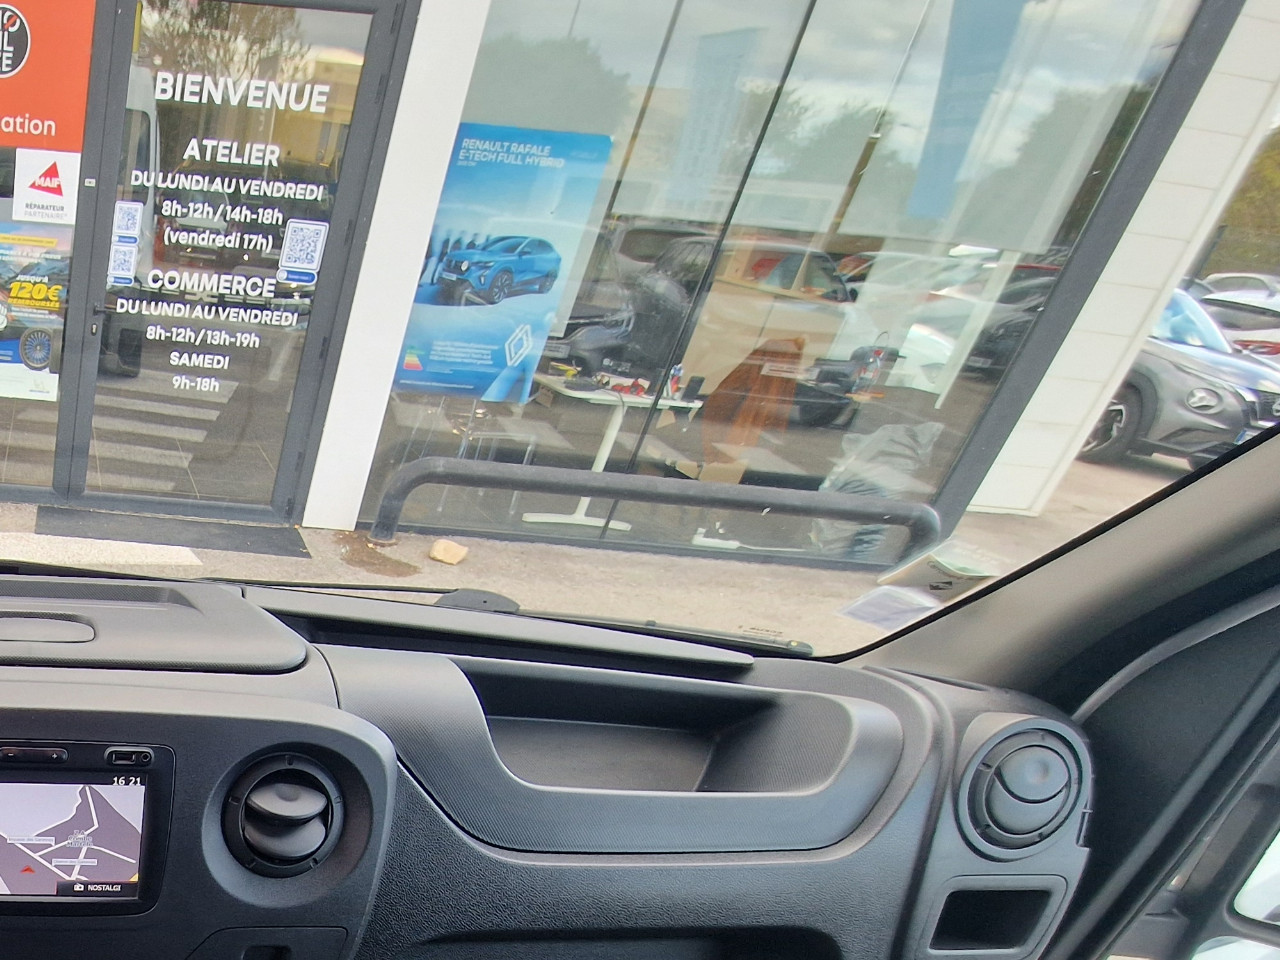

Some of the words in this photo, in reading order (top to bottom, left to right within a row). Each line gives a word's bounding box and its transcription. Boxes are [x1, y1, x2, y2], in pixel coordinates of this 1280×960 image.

[154, 71, 331, 114] BIENVENUE
[183, 138, 280, 167] ATELIER
[462, 138, 509, 152] RENAULT
[510, 143, 551, 156] RAFALE
[459, 149, 497, 162] E-TECH
[496, 153, 523, 165] FULL
[523, 155, 565, 168] HYBRID
[34, 177, 61, 189] MAIF
[130, 170, 156, 187] DU
[157, 172, 210, 192] LUNDI
[210, 176, 238, 194] AU
[239, 179, 324, 201] VENDREDI
[25, 202, 65, 212] RÉPARATEUR
[163, 226, 241, 248] (vendredi
[242, 234, 274, 251] 17h)
[9, 281, 63, 301] 120€
[147, 269, 277, 298] COMMERCE
[116, 298, 140, 314] DU
[141, 300, 191, 318] LUNDI
[191, 303, 217, 320] AU
[218, 305, 299, 327] VENDREDI
[170, 351, 230, 370] SAMEDI
[172, 376, 220, 393] 9h-18h
